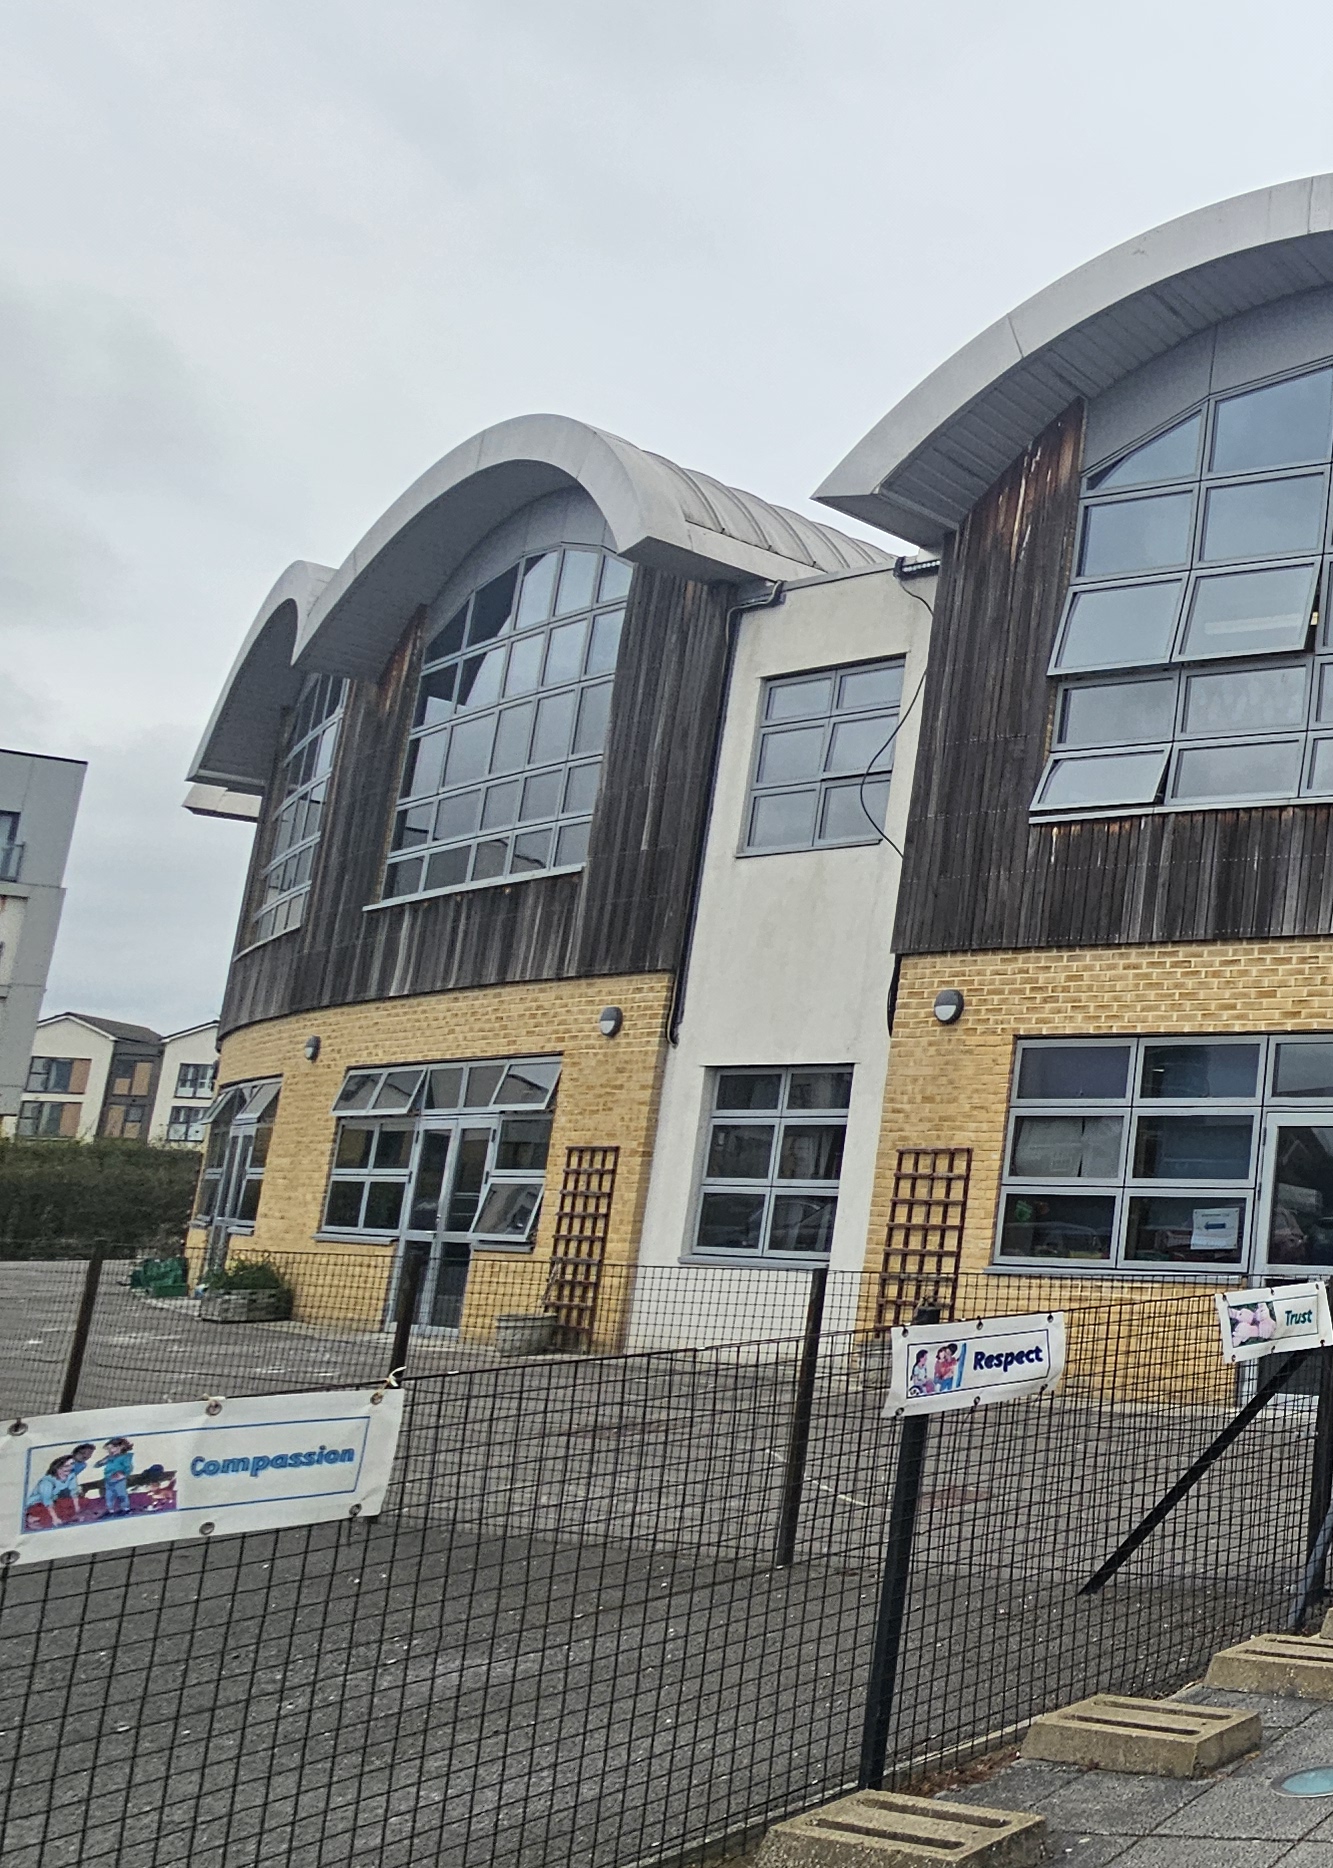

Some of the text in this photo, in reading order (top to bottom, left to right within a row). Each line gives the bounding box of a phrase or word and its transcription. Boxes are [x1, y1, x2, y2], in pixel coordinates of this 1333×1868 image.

[1284, 1309, 1313, 1327] Trust
[972, 1345, 1044, 1373] Respect
[190, 1444, 356, 1478] Compassion
